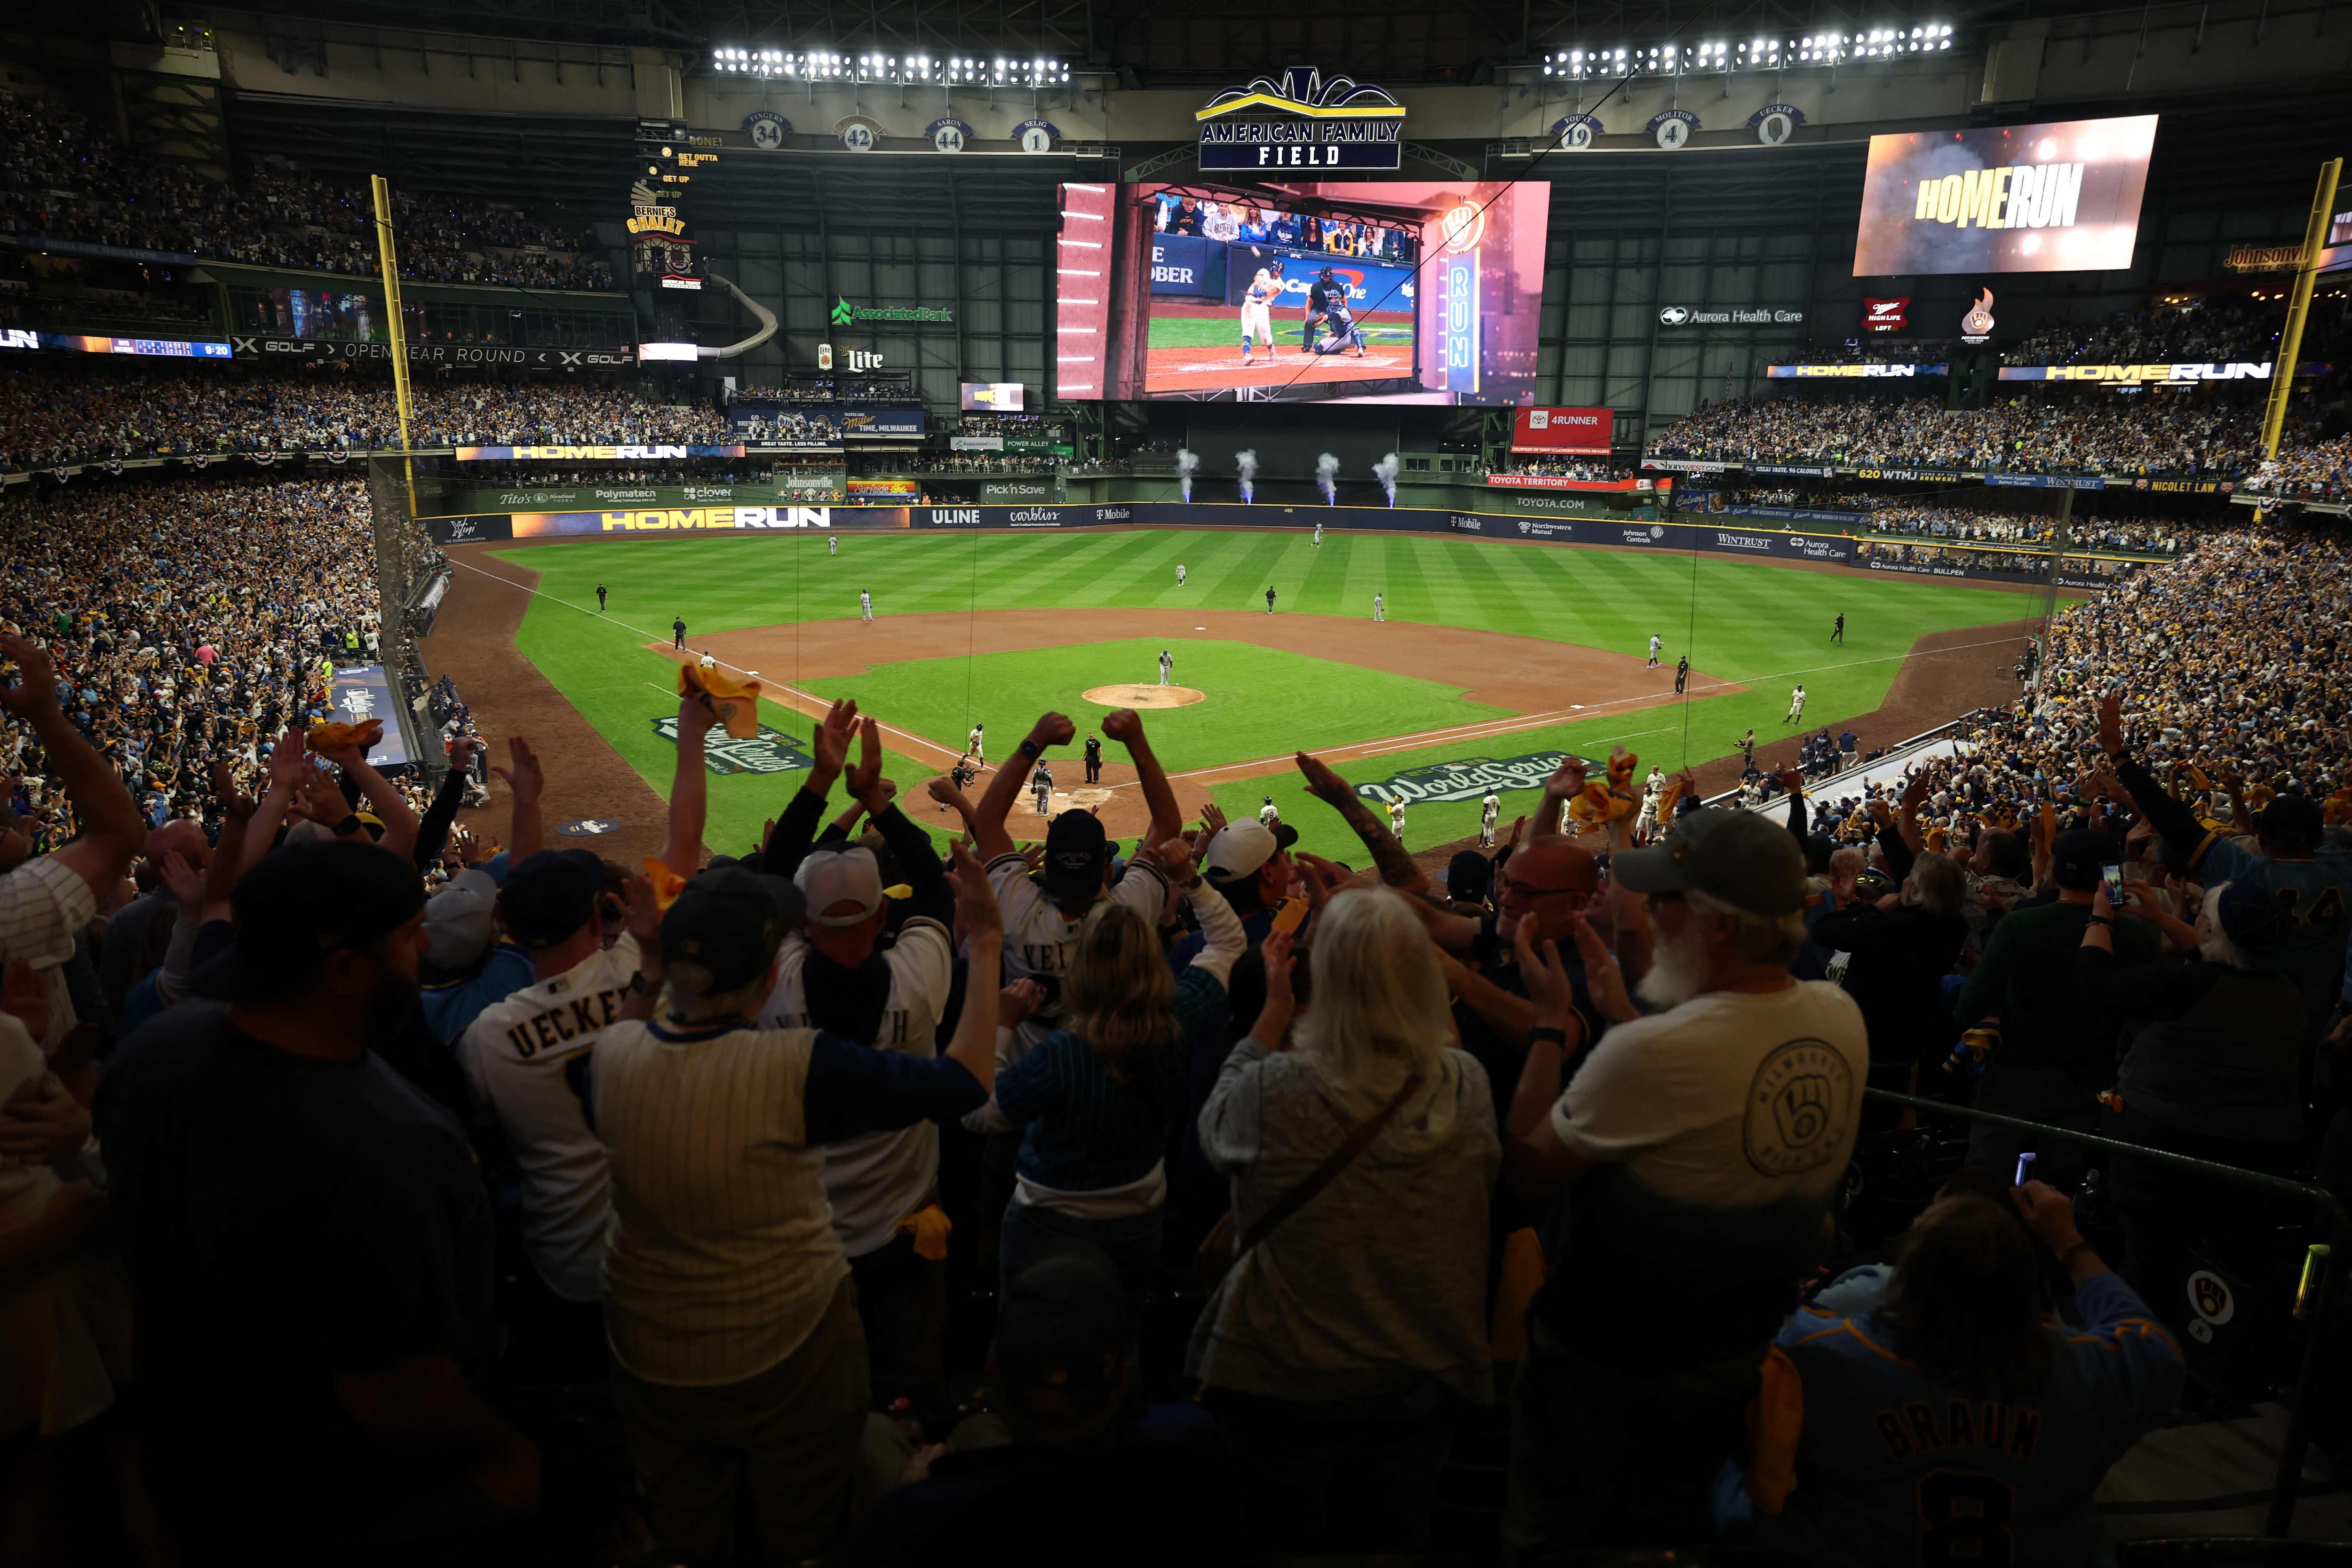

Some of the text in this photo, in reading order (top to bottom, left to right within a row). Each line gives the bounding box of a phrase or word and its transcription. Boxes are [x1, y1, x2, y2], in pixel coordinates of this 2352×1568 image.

[1655, 110, 1693, 123] MOLITOR
[1759, 105, 1794, 116] UECKER
[750, 112, 784, 123] FINGERS
[840, 116, 877, 127] ROBINSON
[937, 119, 962, 127] AARON
[1564, 115, 1593, 124] YOUNT
[1025, 120, 1047, 128] SELIG
[756, 126, 779, 143] 34
[848, 129, 870, 147] 42
[1200, 121, 1402, 143] AMERICAN FAMILY
[1565, 129, 1589, 147] 19
[1664, 125, 1678, 143] 4
[689, 135, 723, 147] GONE!
[938, 132, 961, 149] 44
[1032, 134, 1041, 151] 1
[1258, 145, 1340, 166] FIELD
[635, 206, 676, 217] BERNIE'S
[627, 215, 685, 236] CHALET
[2240, 264, 2272, 272] PARTY
[1872, 302, 1900, 315] Miller
[1689, 309, 1803, 323] Aurora Health Care
[205, 345, 228, 356] 9:20
[232, 337, 259, 353] X
[265, 341, 315, 353] GOLF
[345, 343, 392, 358] OPEN
[457, 348, 525, 362] ROUND
[559, 352, 583, 365] X
[587, 354, 634, 364] GOLF
[837, 344, 862, 357] Miller
[847, 349, 883, 373] Lite
[841, 415, 876, 431] Miller
[1551, 416, 1598, 425] 4RUNNER
[1660, 460, 1724, 473] ShoreWEST.COM
[1490, 475, 1569, 486] TOYOTA TERRITORY
[1859, 469, 1917, 480] 620 WTMJ
[786, 476, 834, 489] Johnsonville
[854, 483, 890, 494] Surfside
[2151, 481, 2217, 493] NICOLET LAW
[421, 485, 443, 496] Yard
[596, 489, 656, 499] Polymatech
[697, 487, 732, 497] clover
[986, 485, 1008, 494] Pick
[1019, 484, 1045, 494] Save
[500, 493, 530, 505] Tito's
[1517, 498, 1585, 509] TOYOTA.COM
[1676, 493, 1706, 507] Culver's
[932, 509, 980, 524] ULINE
[1010, 507, 1061, 522] carbliss
[1104, 508, 1130, 519] Mobile
[1458, 516, 1481, 530] Mobile
[1531, 523, 1572, 531] Northwestern
[1717, 533, 1771, 547] WINTRUST
[1805, 540, 1829, 549] Aurora
[1804, 548, 1846, 558] Health Care
[1933, 568, 1964, 576] BULLPEN
[1359, 764, 1491, 804] World
[1877, 1399, 2042, 1461] BRAUN
